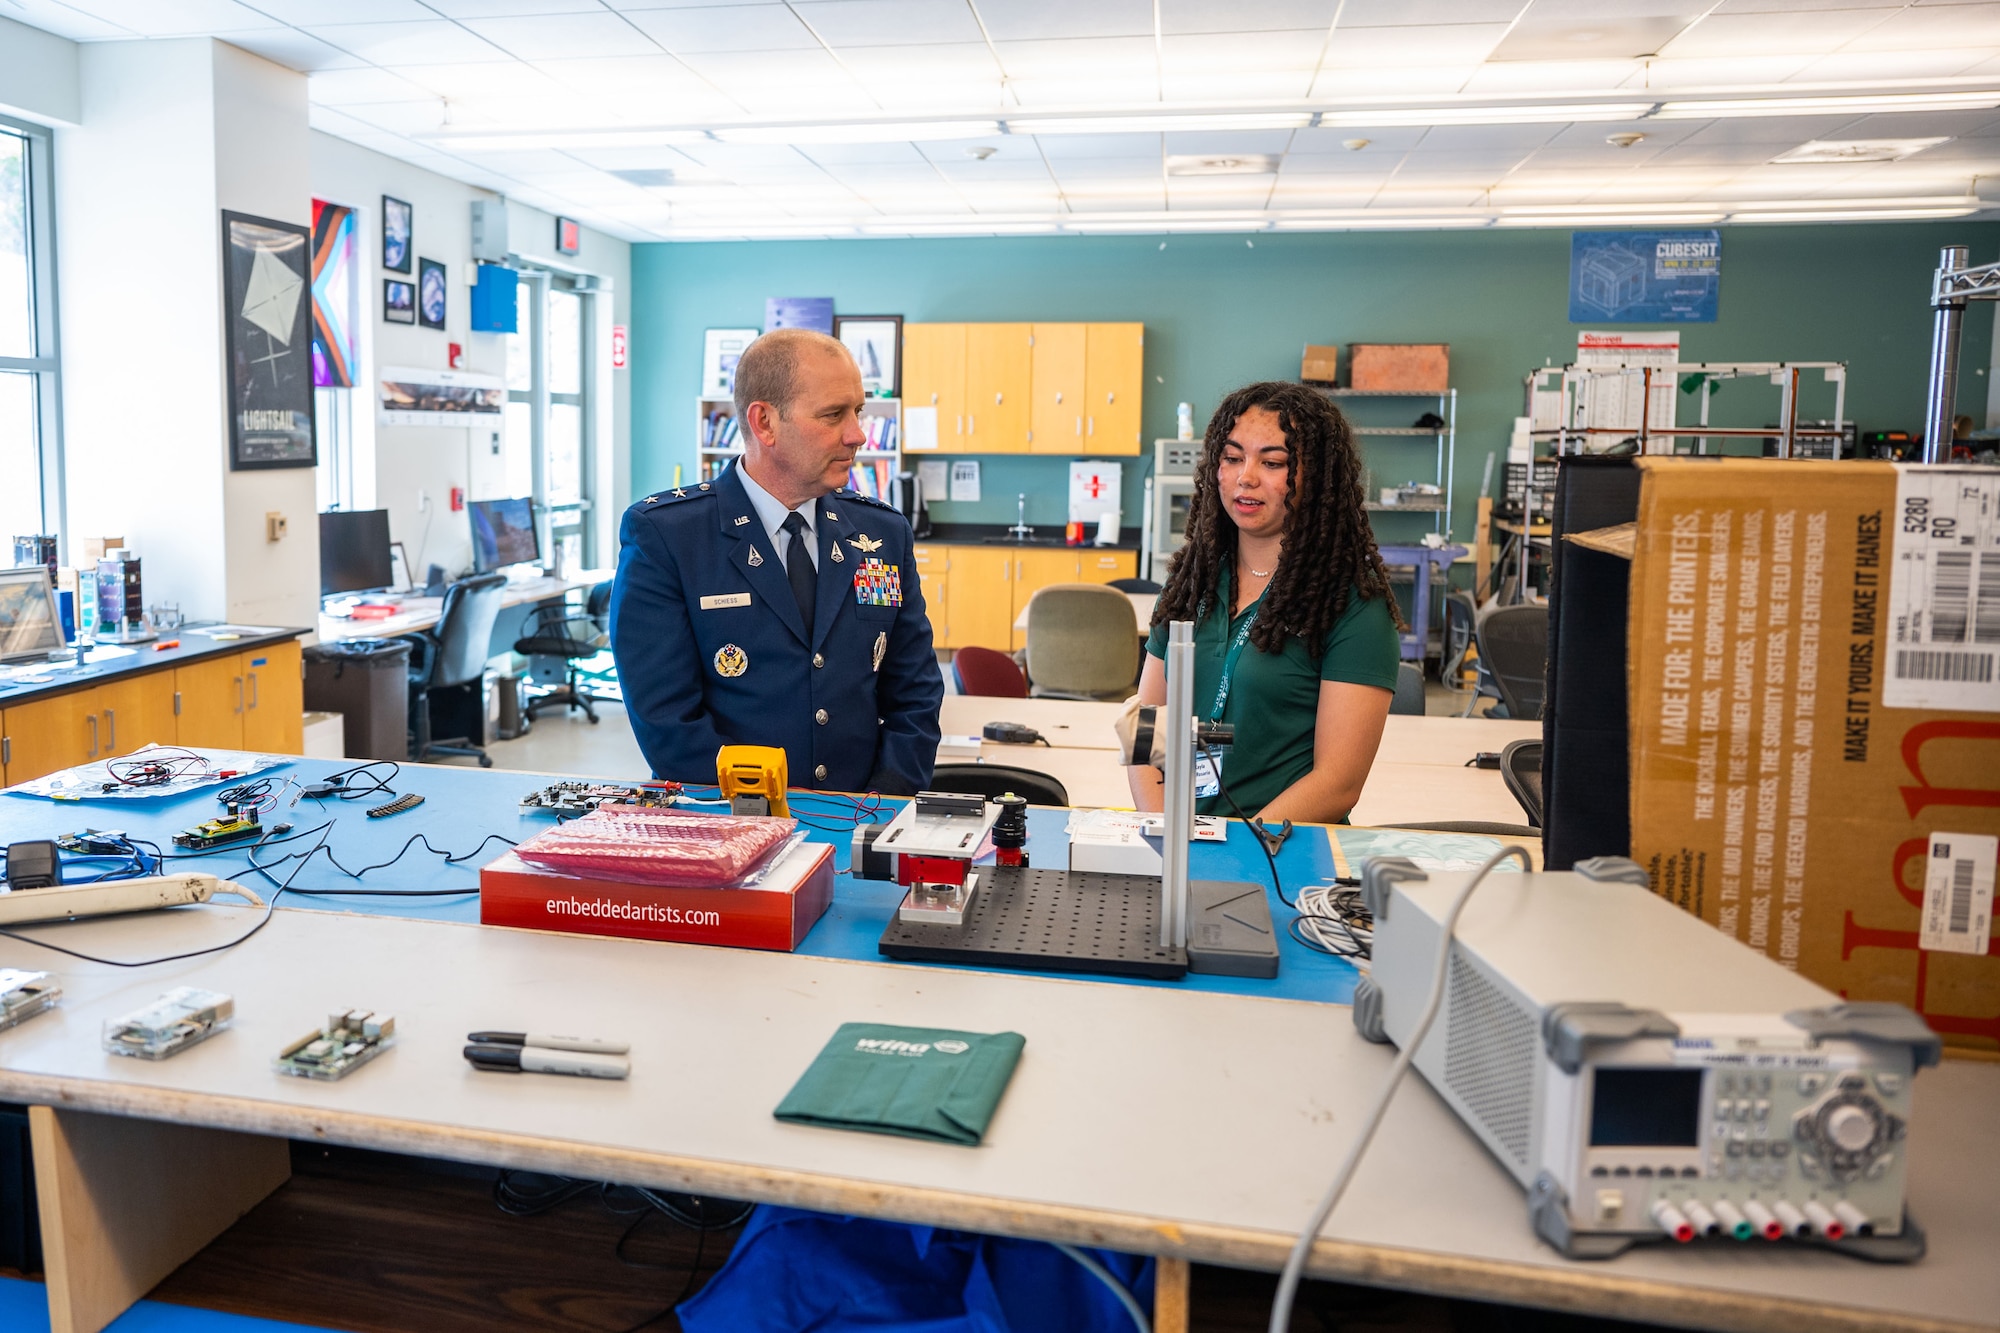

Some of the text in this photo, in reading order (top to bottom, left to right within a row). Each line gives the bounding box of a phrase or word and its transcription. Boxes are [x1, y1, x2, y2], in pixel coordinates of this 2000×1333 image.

[1656, 242, 1718, 257] CUBESAT
[243, 409, 295, 431] LIGHTSAIL
[1742, 510, 1764, 556] BANDS,
[1904, 498, 1929, 533] 5280
[1932, 517, 1956, 539] RO
[1738, 558, 1759, 608] GARAGE
[1801, 510, 1827, 620] ENTREPRENEURS.
[714, 598, 738, 606] SCHIESS
[1737, 610, 1757, 633] THE
[1661, 509, 1702, 745] MADE FOR: THE PRINTERS,
[1844, 511, 1882, 762] MAKE IT YOURS. MAKE IT HANES.
[1695, 510, 1733, 819] THE KICKBALL TEAMS, THE CORPORATE SWAGGERS,
[1733, 637, 1757, 700] CAMPERS,
[1797, 622, 1819, 690] ENERGETIC
[1795, 692, 1816, 716] THE
[1730, 703, 1751, 756] SUMMER
[1750, 510, 1797, 945] DONORS, THE FUND RAISERS, THE SORORITY SISTERS, THE FIELD DAYERS,
[1794, 719, 1814, 746] AND
[1729, 759, 1748, 781] THE
[1788, 749, 1815, 816] WARRIORS,
[1724, 785, 1749, 845] RUNNERS,
[1722, 848, 1741, 875] MUD
[1785, 819, 1807, 877] WEEKEND
[546, 896, 720, 927] embeddedartists.com
[1720, 878, 1738, 900] THE
[1784, 880, 1803, 903] THE
[1779, 907, 1802, 957] GROUPS,
